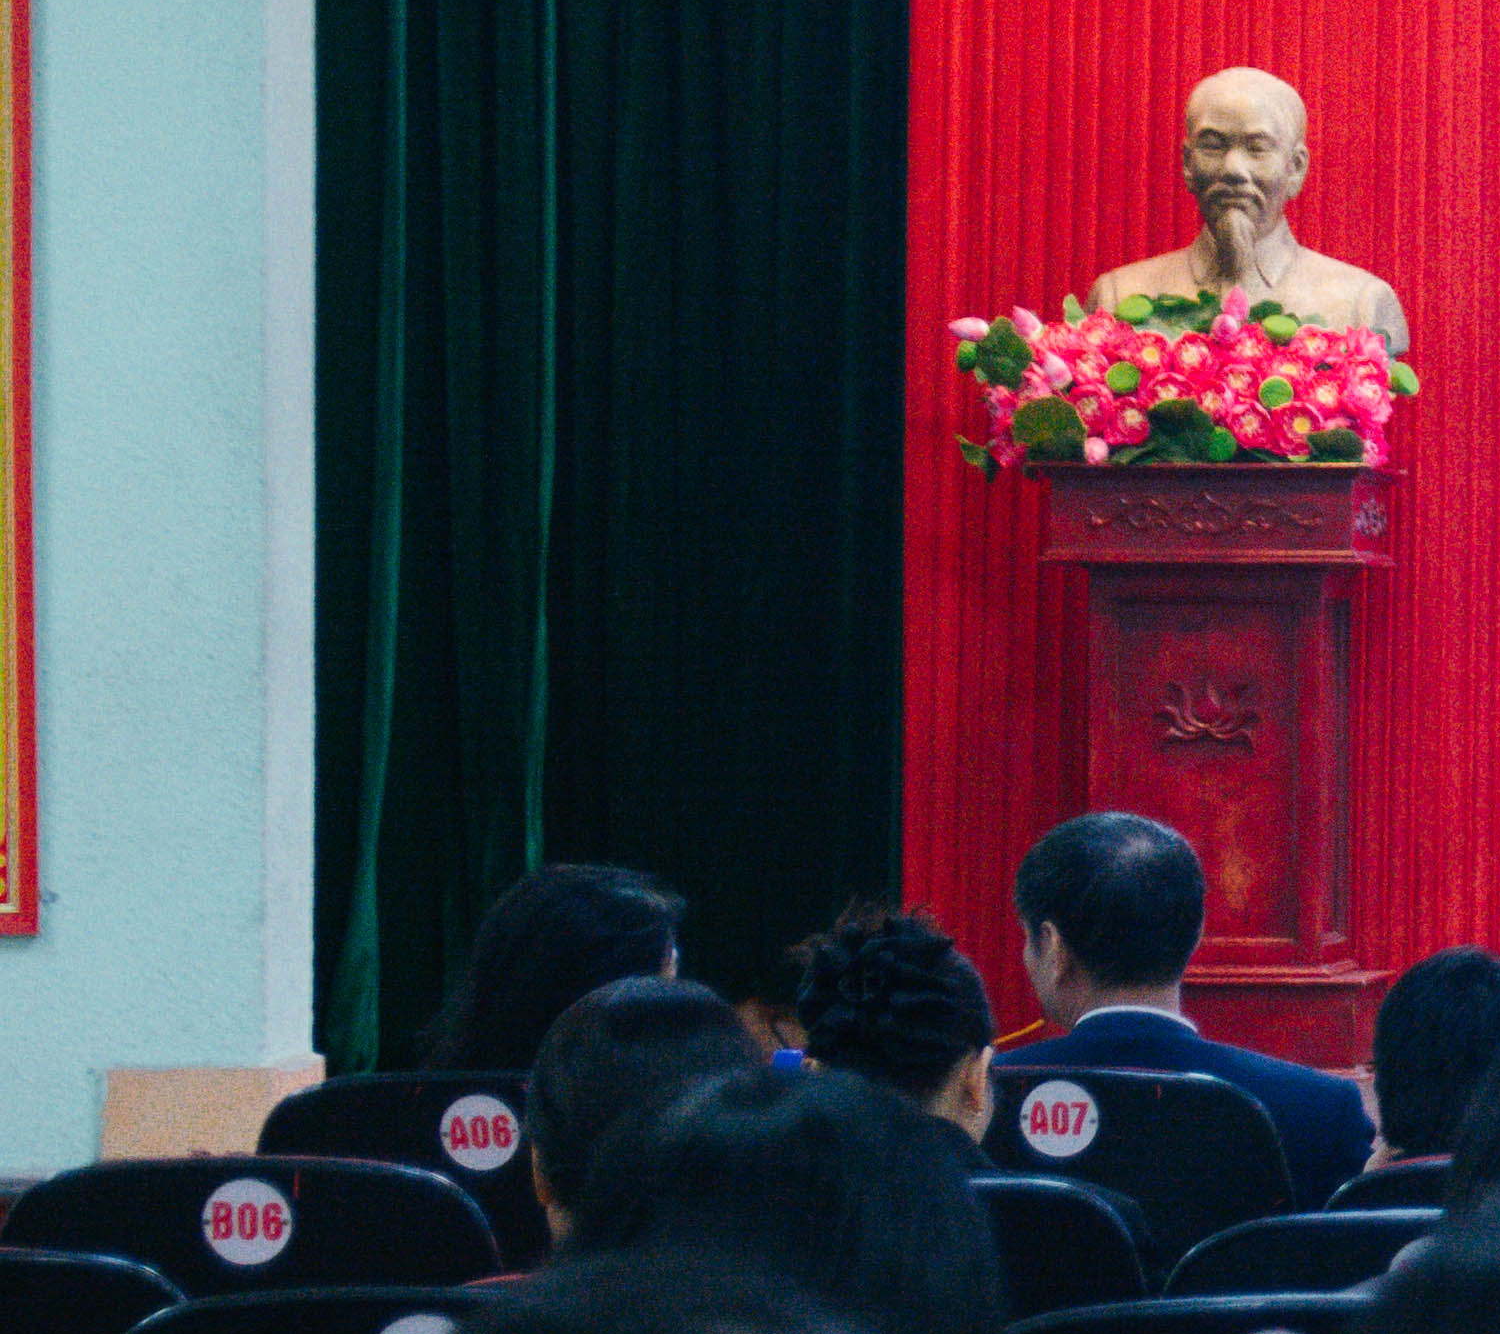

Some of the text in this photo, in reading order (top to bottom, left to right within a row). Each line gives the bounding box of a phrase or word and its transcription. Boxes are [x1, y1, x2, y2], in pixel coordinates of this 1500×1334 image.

[448, 1117, 512, 1150] A06
[1029, 1101, 1087, 1136] A07
[211, 1203, 281, 1241] B06
